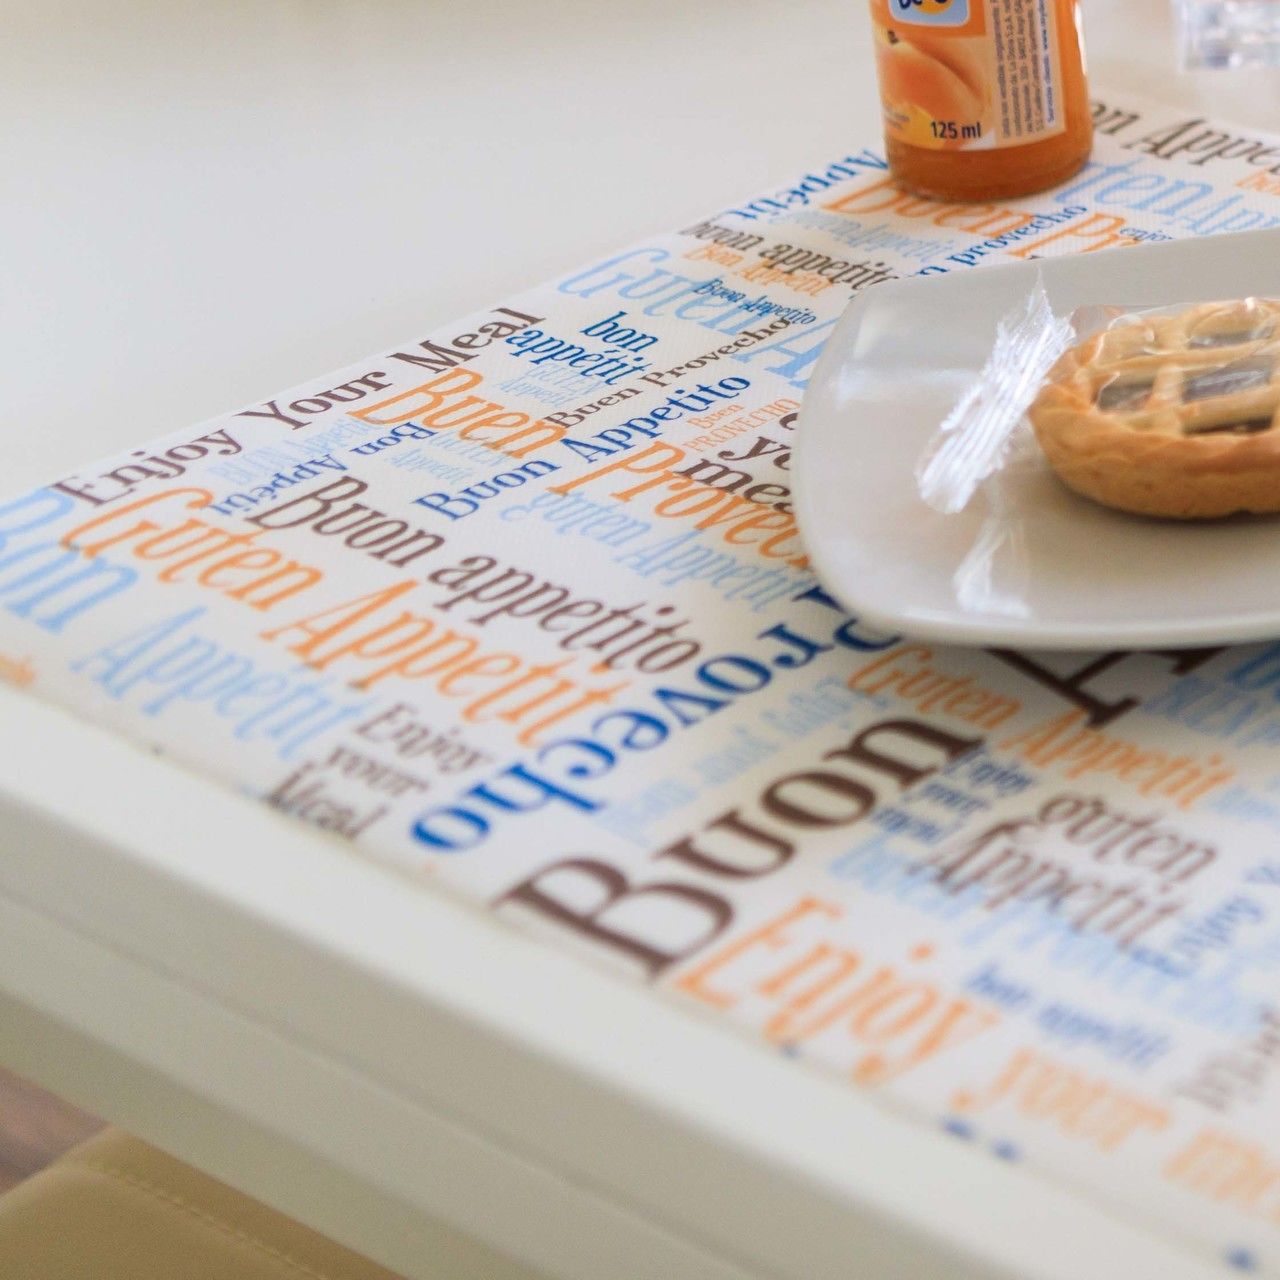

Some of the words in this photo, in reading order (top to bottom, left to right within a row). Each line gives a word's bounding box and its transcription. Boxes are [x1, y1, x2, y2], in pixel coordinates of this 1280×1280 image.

[930, 121, 958, 140] 125
[961, 120, 982, 139] ml
[1054, 156, 1214, 217] ten
[556, 246, 775, 337] Guten
[580, 310, 660, 353] bon
[504, 328, 655, 386] appétit
[542, 385, 643, 429] Buen
[639, 314, 794, 388] Provecho
[50, 427, 244, 509] Enjoy
[232, 370, 394, 432] Your
[386, 306, 548, 376] Meal
[350, 420, 438, 458] Bon
[411, 459, 563, 522] Buon
[558, 374, 752, 464] Appetito
[208, 452, 349, 518] Appétit
[350, 366, 568, 460] Buen
[547, 440, 811, 571] Provec
[672, 458, 793, 515] me
[59, 485, 324, 613] Guten
[259, 578, 636, 748] Appetit
[243, 474, 446, 569] Buon
[426, 553, 704, 675] appetito
[846, 644, 1021, 731] Guten
[353, 703, 500, 776] Enjoy
[487, 714, 987, 988] Buon
[672, 892, 1004, 1099] Enjoy
